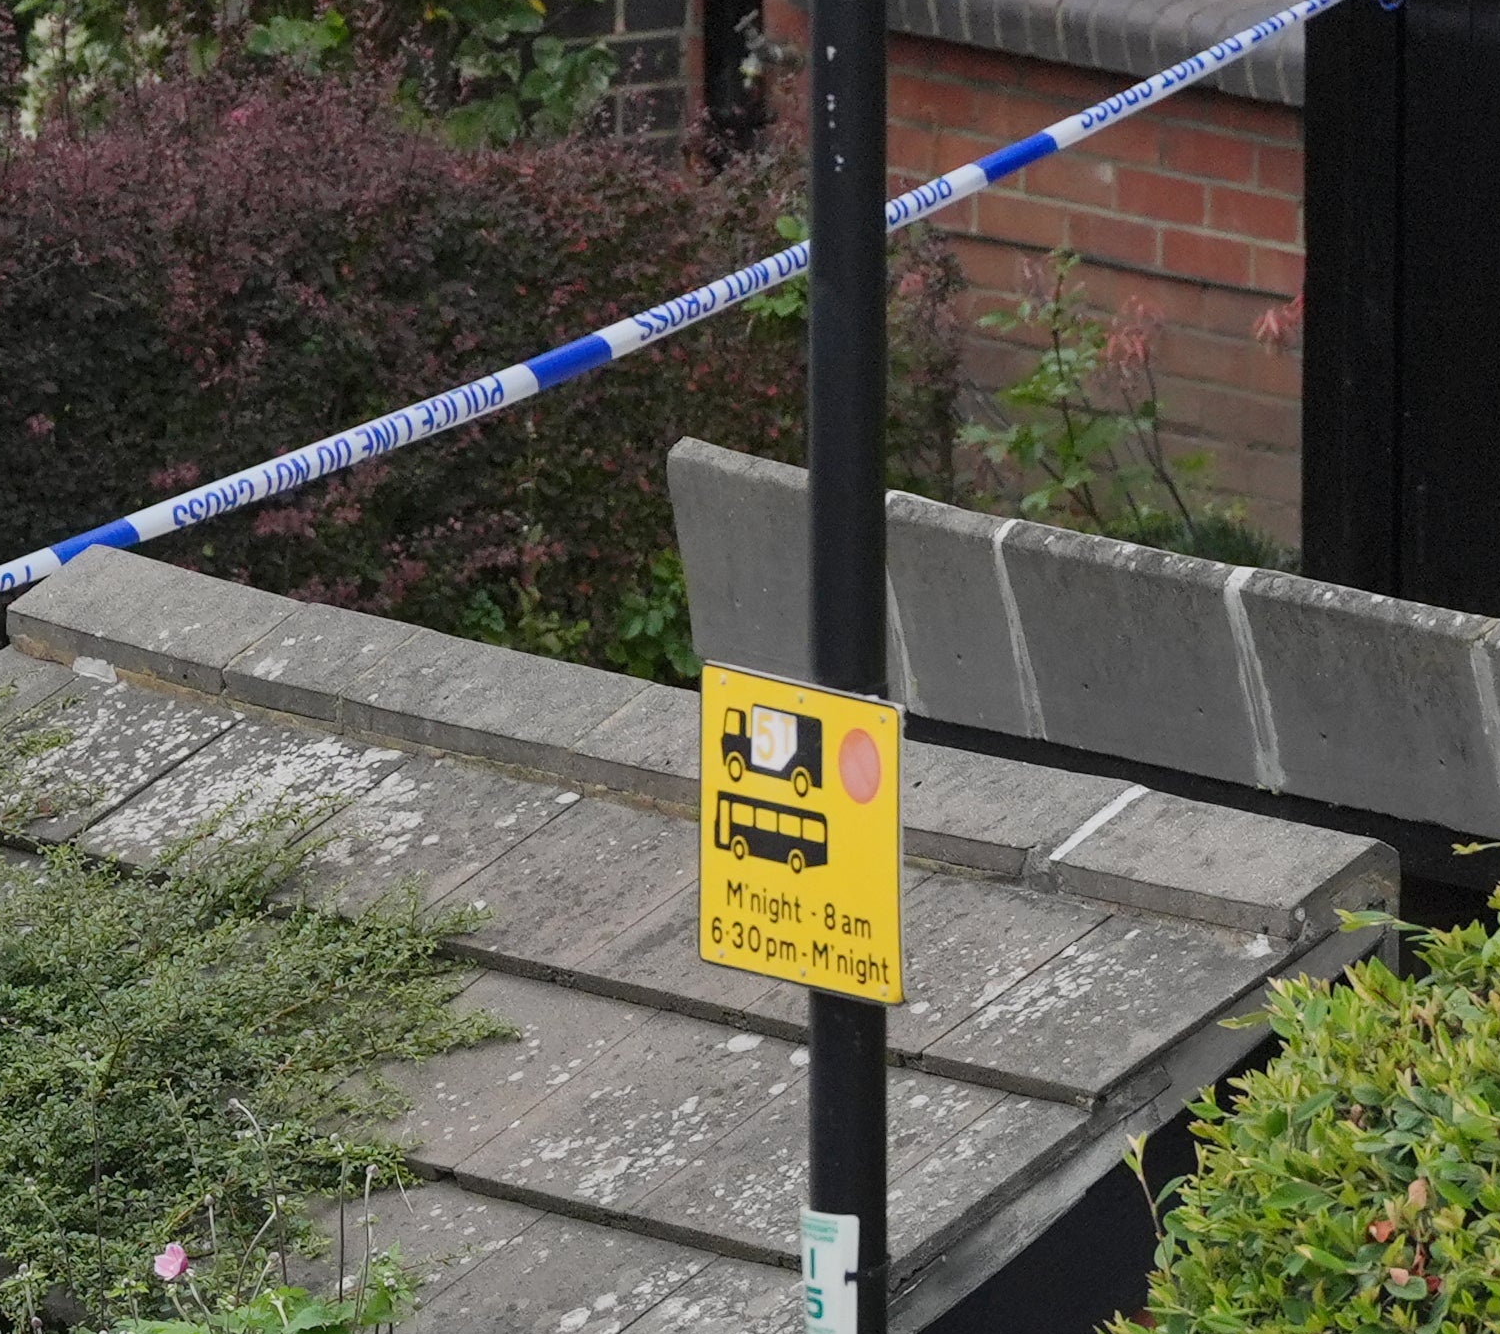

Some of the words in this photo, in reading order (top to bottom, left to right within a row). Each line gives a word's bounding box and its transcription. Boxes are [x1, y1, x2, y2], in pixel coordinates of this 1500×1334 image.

[888, 174, 953, 226] POLIC
[722, 262, 770, 304] NOT
[772, 244, 808, 278] DO
[632, 285, 717, 342] CROSS
[421, 372, 506, 436] POLICE
[316, 437, 353, 475] DO
[359, 411, 414, 459] LINE
[171, 477, 257, 529] CROSS
[726, 878, 803, 924] M'night
